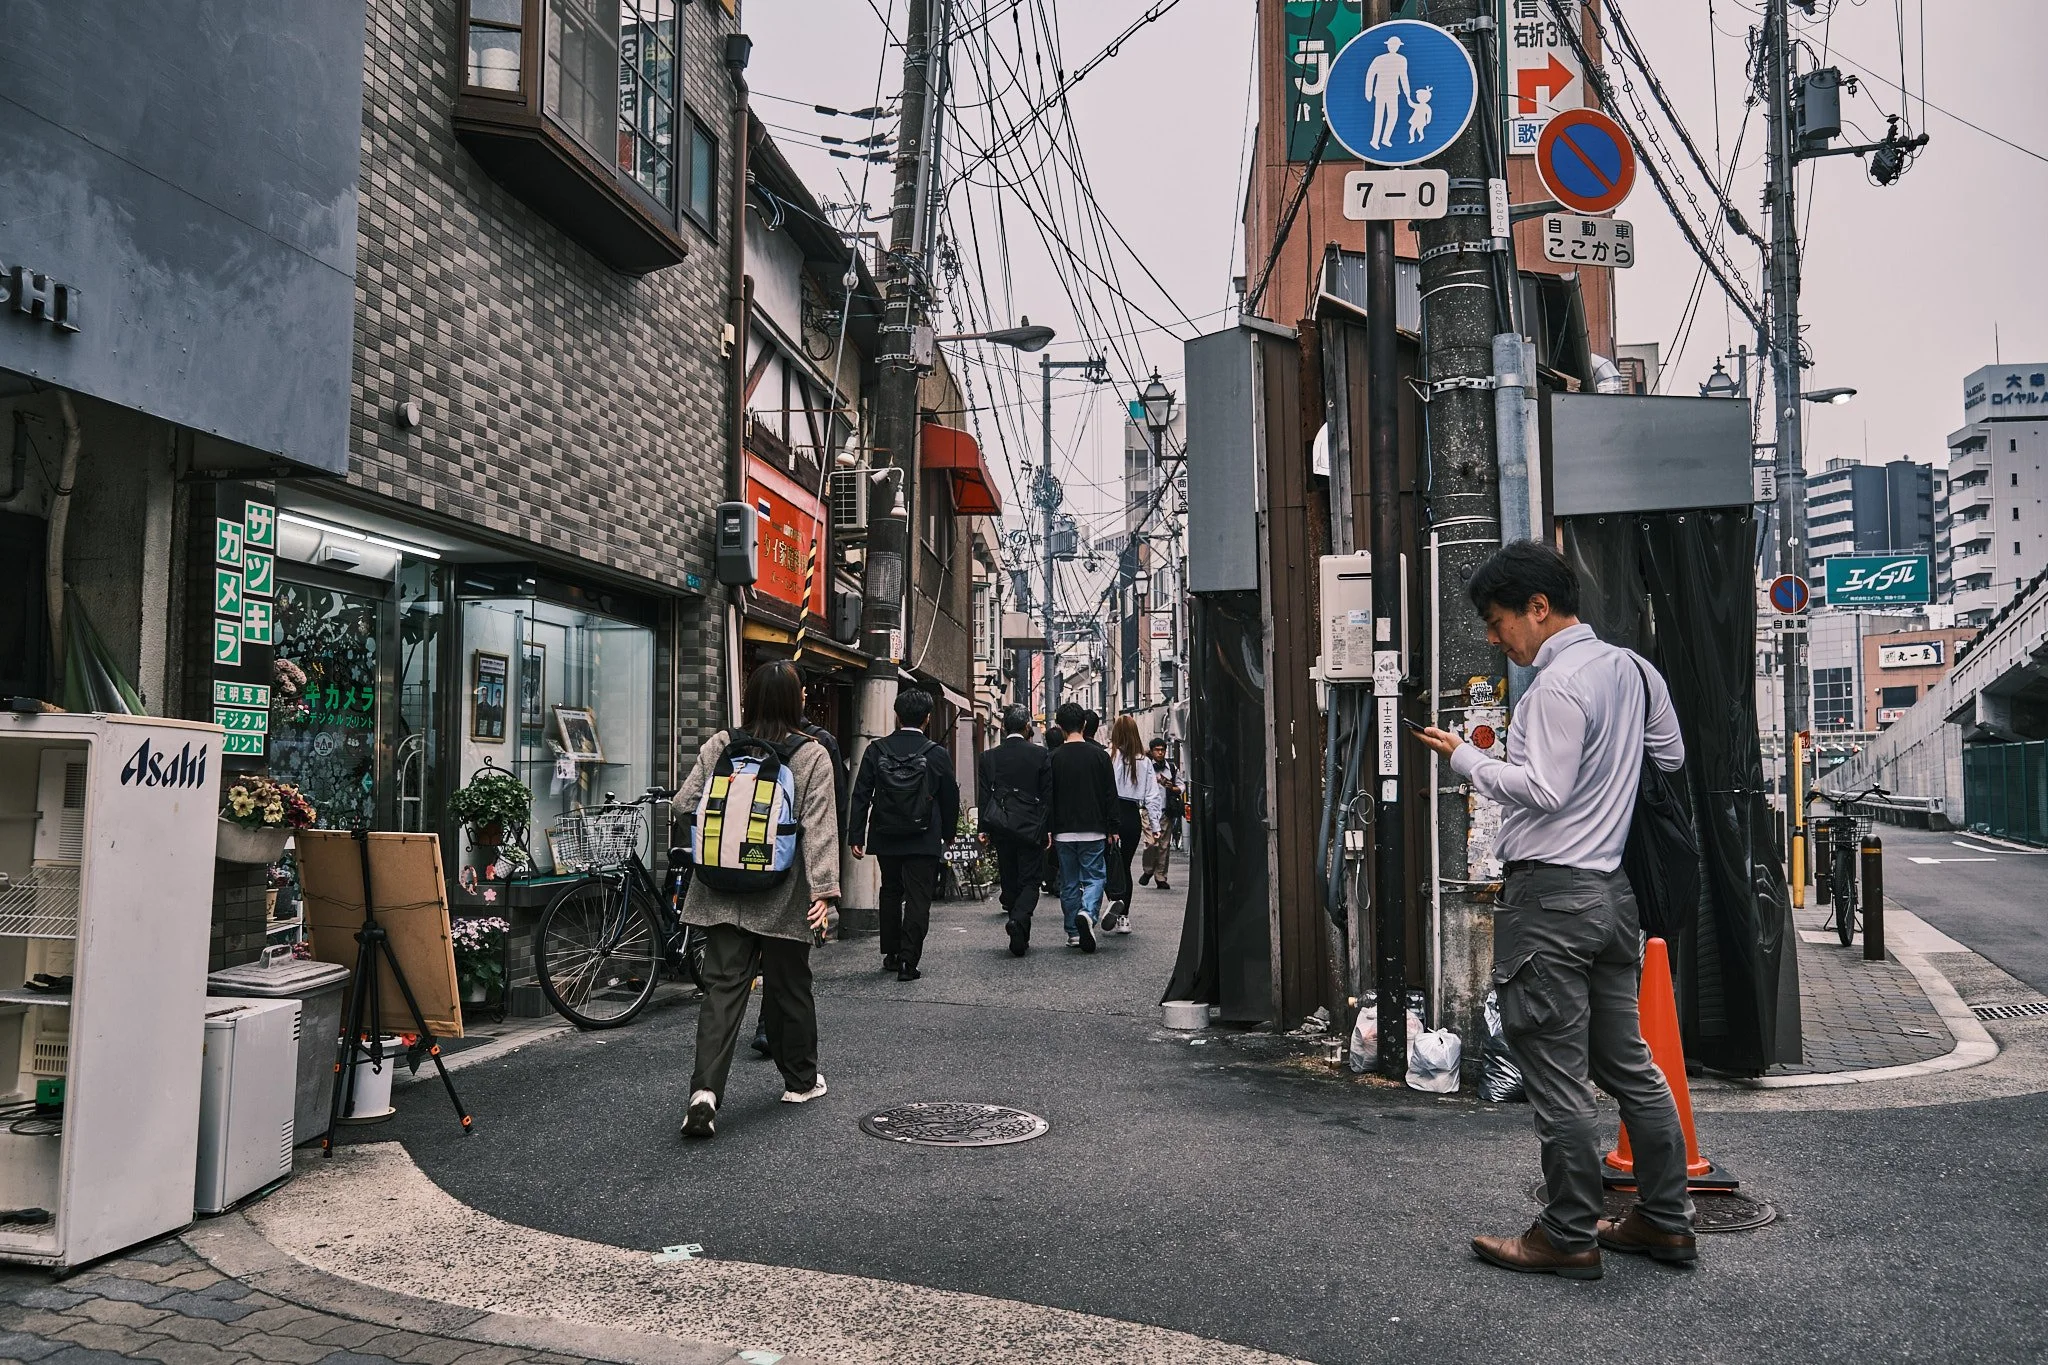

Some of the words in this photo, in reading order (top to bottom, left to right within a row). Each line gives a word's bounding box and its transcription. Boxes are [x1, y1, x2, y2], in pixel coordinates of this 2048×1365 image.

[1513, 21, 1571, 48] 右折3
[1518, 123, 1545, 143] 歌
[1548, 218, 1630, 240] 自動車
[1549, 238, 1630, 264] ここから
[245, 507, 272, 639] サツキ
[1836, 559, 1918, 592] エイブル
[217, 524, 241, 660] カメラ
[1774, 619, 1807, 630] 自動車
[216, 684, 268, 705] 証明写真
[216, 711, 265, 729] デジタル
[120, 737, 207, 789] Asahi
[943, 850, 978, 861] OPEN
